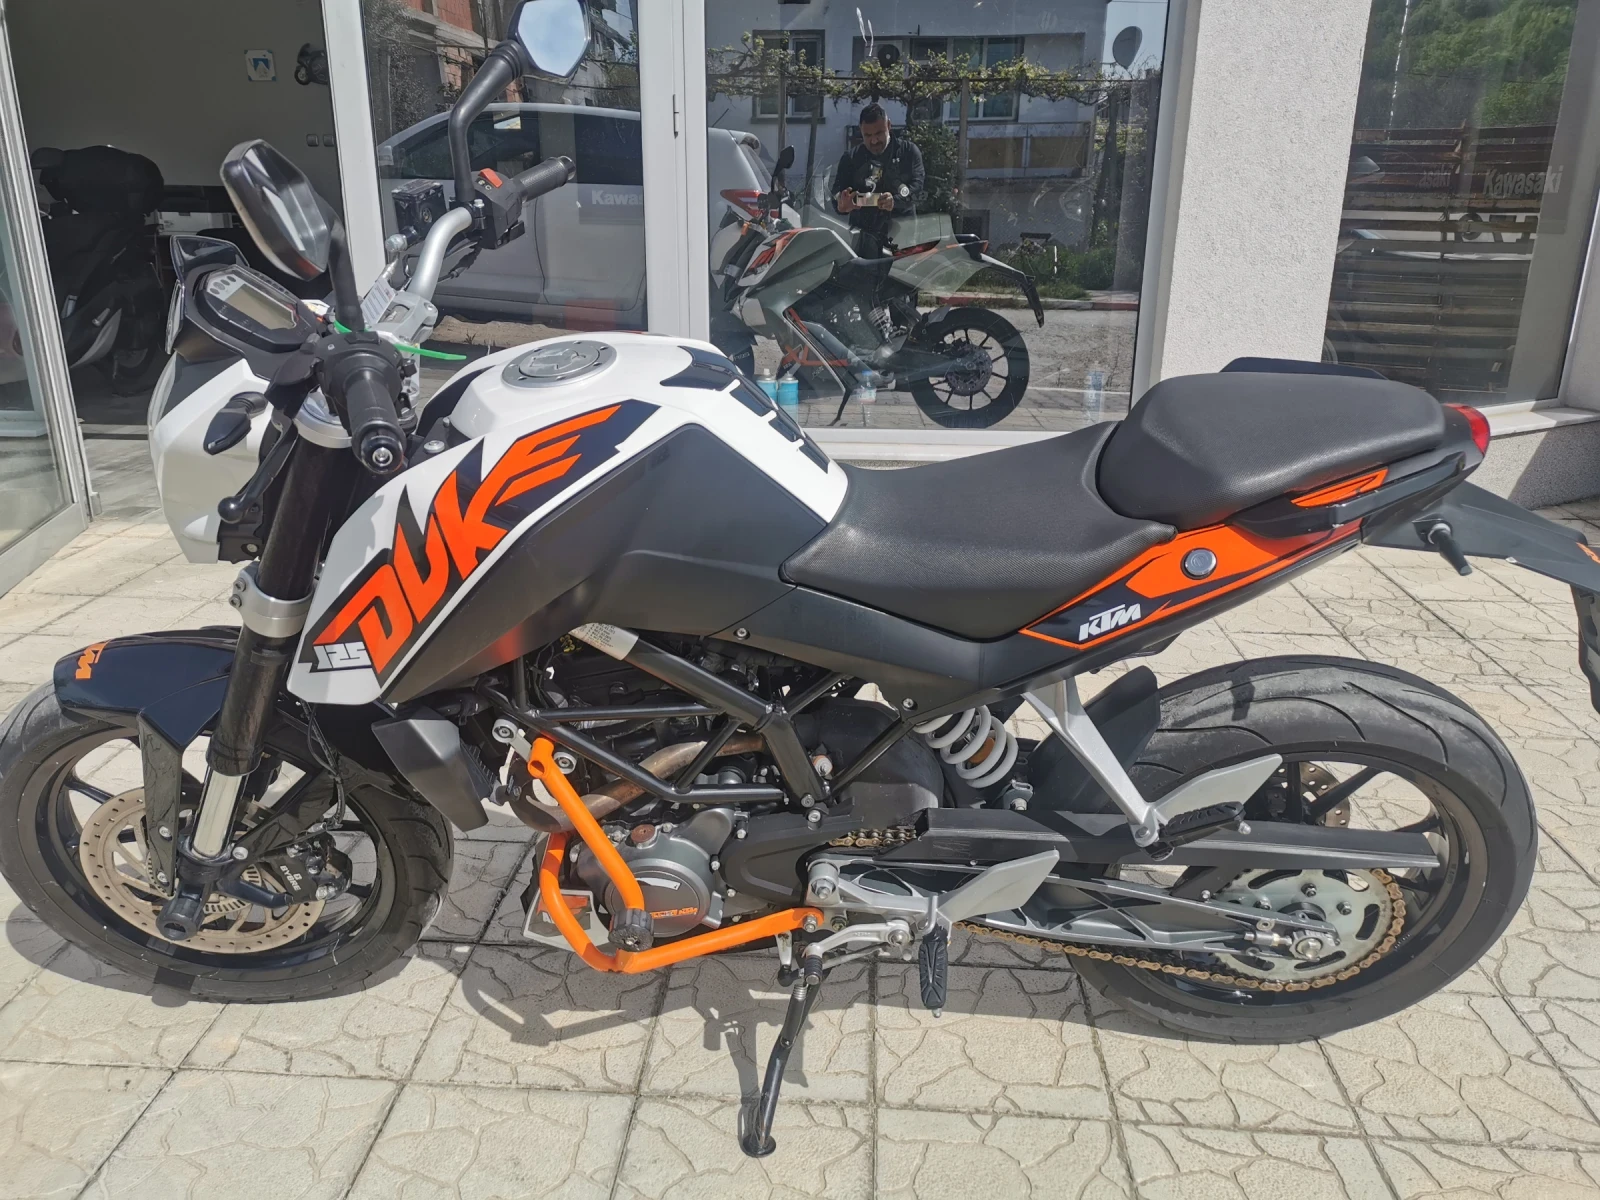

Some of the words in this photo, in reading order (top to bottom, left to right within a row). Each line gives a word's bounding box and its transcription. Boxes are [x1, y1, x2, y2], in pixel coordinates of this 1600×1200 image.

[1483, 165, 1564, 194] Kawasaki
[313, 405, 622, 674] DUKE
[1079, 603, 1141, 641] KTM
[313, 641, 372, 669] 125
[280, 865, 301, 891] BYBRE
